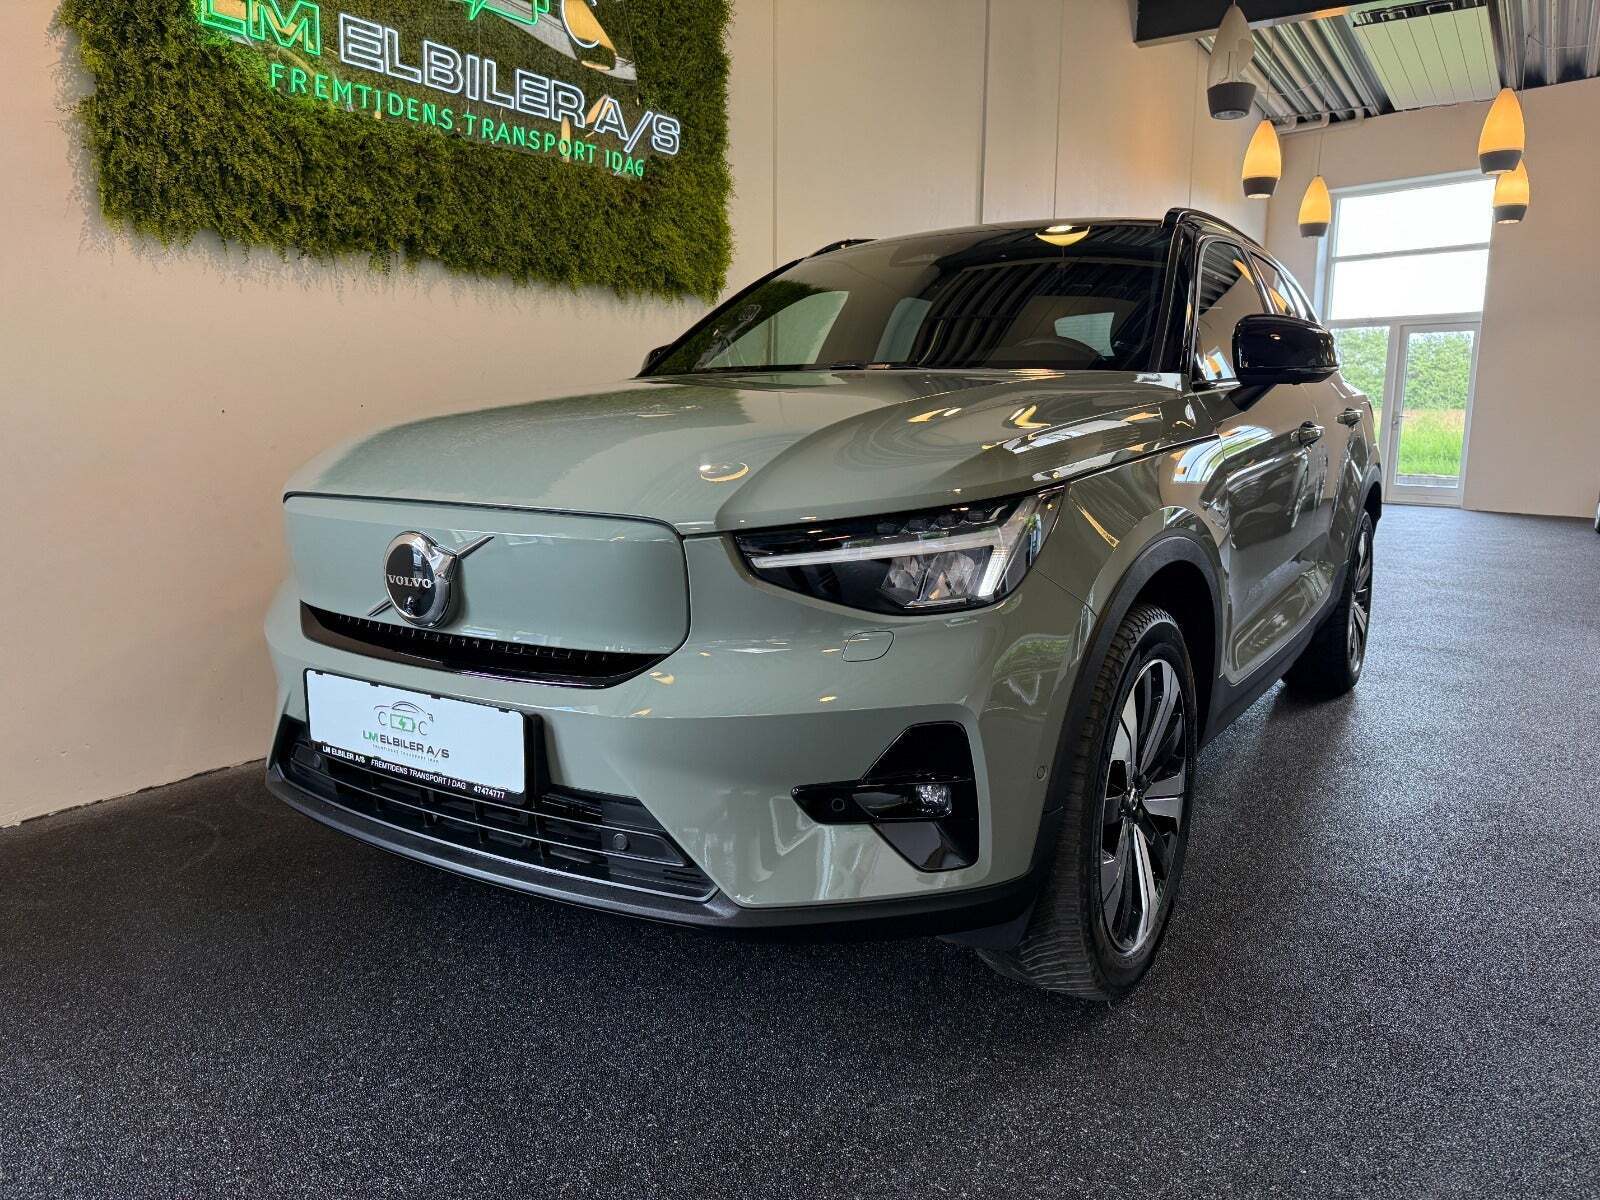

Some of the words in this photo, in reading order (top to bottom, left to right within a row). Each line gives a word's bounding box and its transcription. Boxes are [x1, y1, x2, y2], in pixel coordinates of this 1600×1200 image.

[200, 0, 321, 56] LM
[338, 12, 587, 129] ELBILER
[595, 97, 681, 156] A/S
[270, 63, 454, 131] FREMTIDENS
[464, 113, 597, 164] TRANSPORT
[604, 149, 645, 178] IDAG
[388, 574, 433, 589] VOLVO
[362, 730, 379, 743] LM
[379, 734, 424, 753] ELBILER
[426, 745, 450, 759] A/S
[331, 748, 355, 761] ELBILER
[371, 759, 408, 775] FREMTIDENS
[409, 768, 447, 786] TRANSPORT
[451, 780, 466, 790] DAG
[473, 785, 505, 799] 47474777
